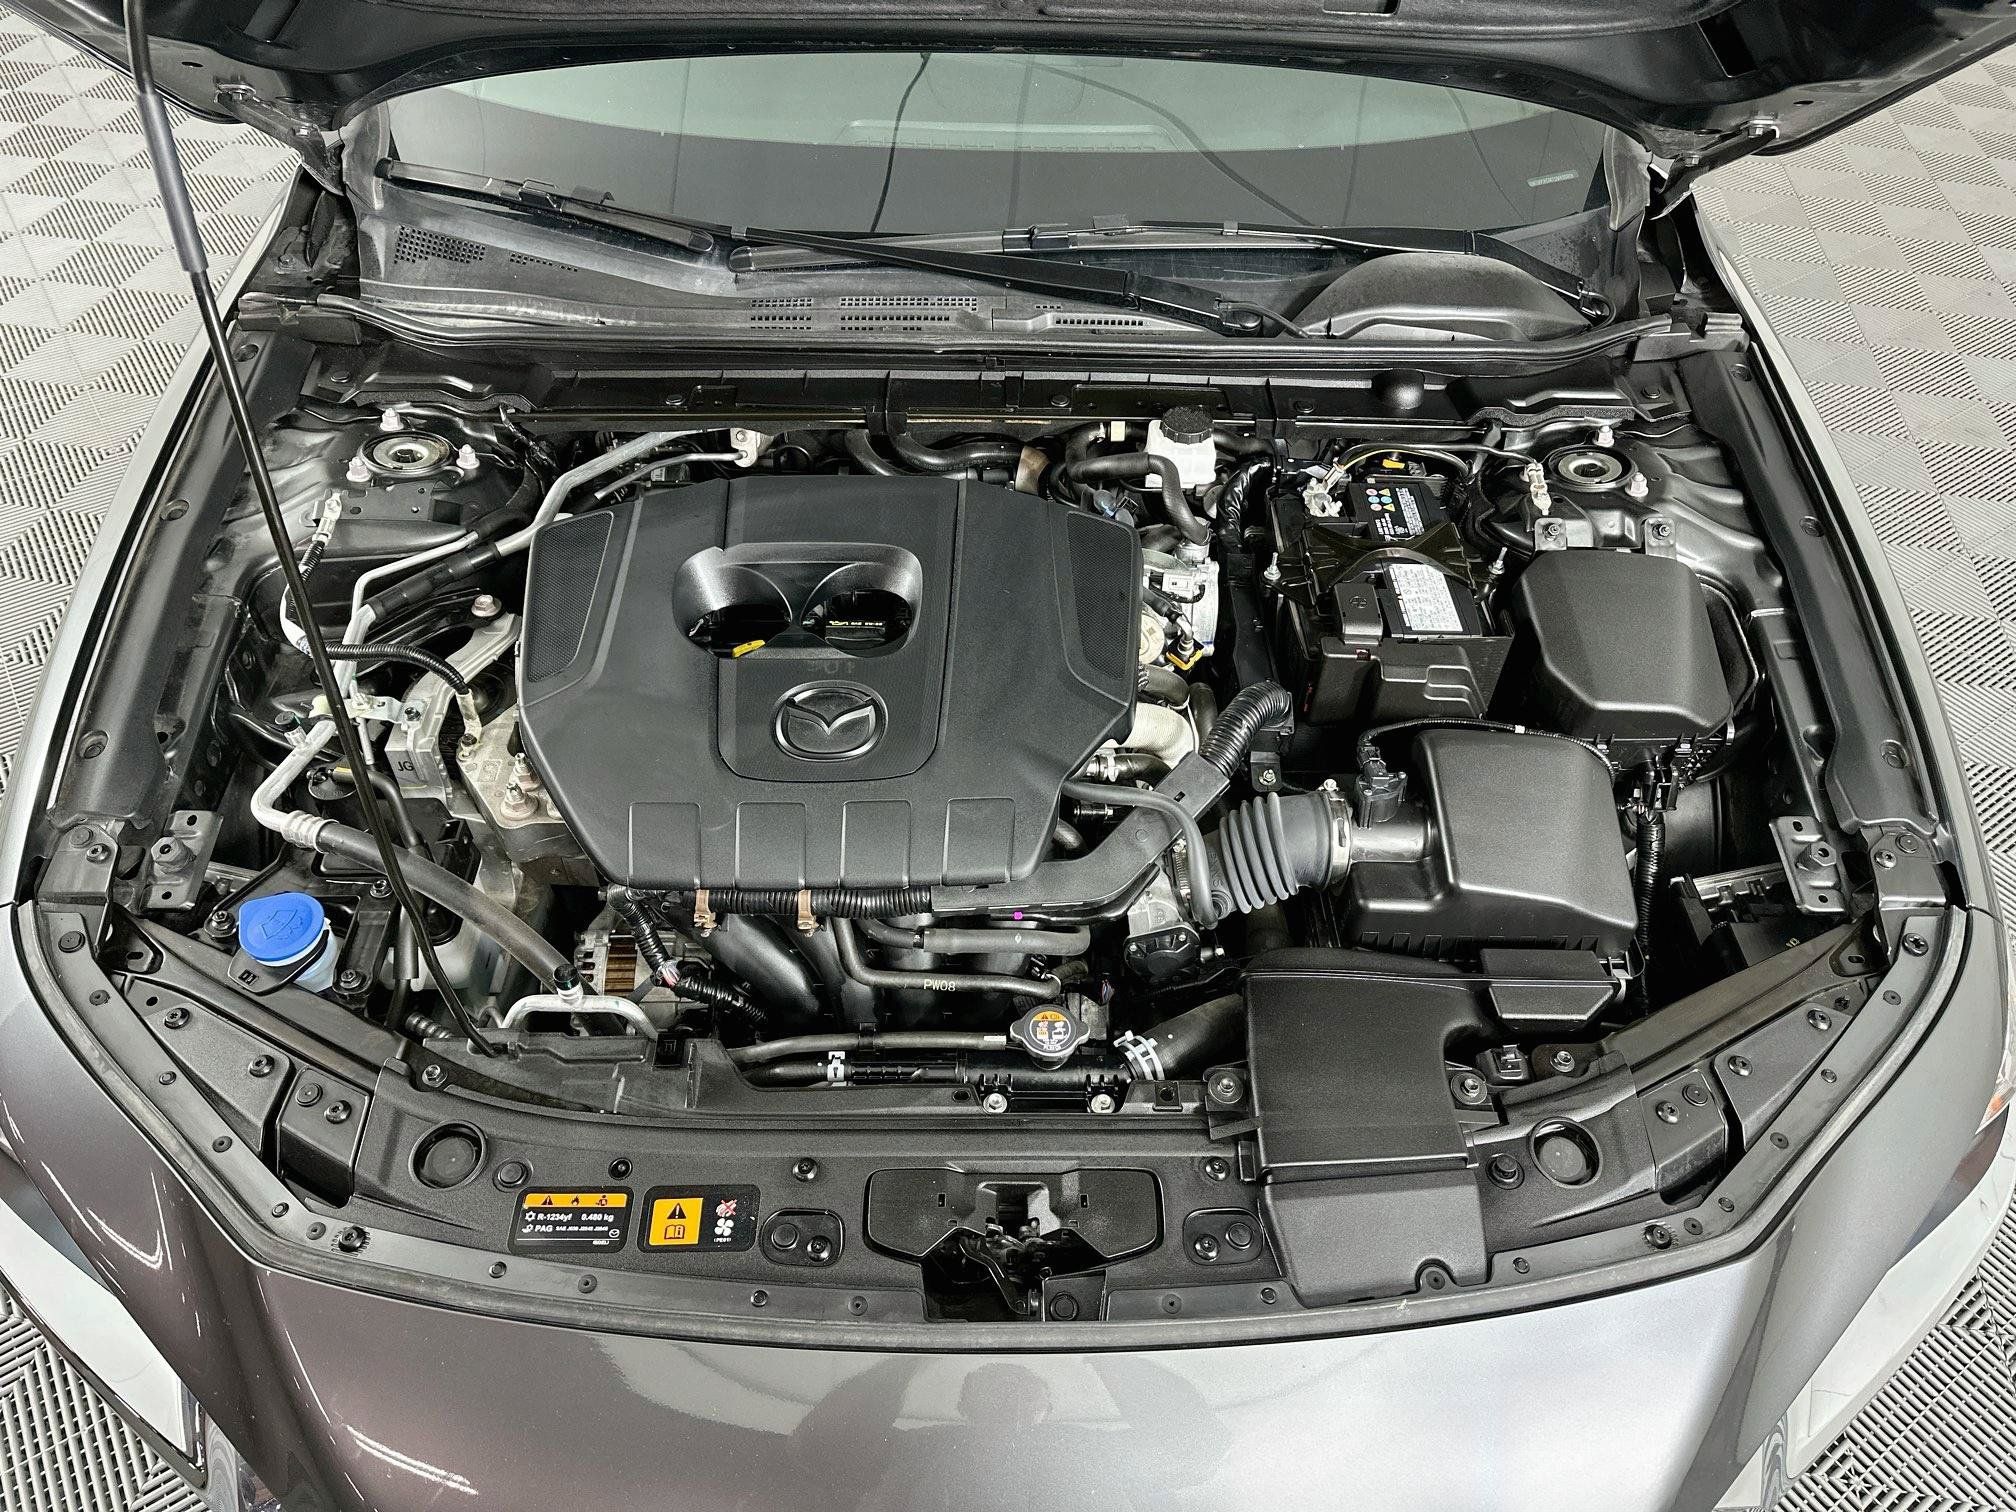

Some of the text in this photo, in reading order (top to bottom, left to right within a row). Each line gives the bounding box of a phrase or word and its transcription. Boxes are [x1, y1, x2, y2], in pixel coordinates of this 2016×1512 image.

[397, 761, 415, 772] JG
[923, 979, 956, 991] PW08
[537, 1213, 573, 1222] R-1234yf
[603, 1213, 614, 1222] kg
